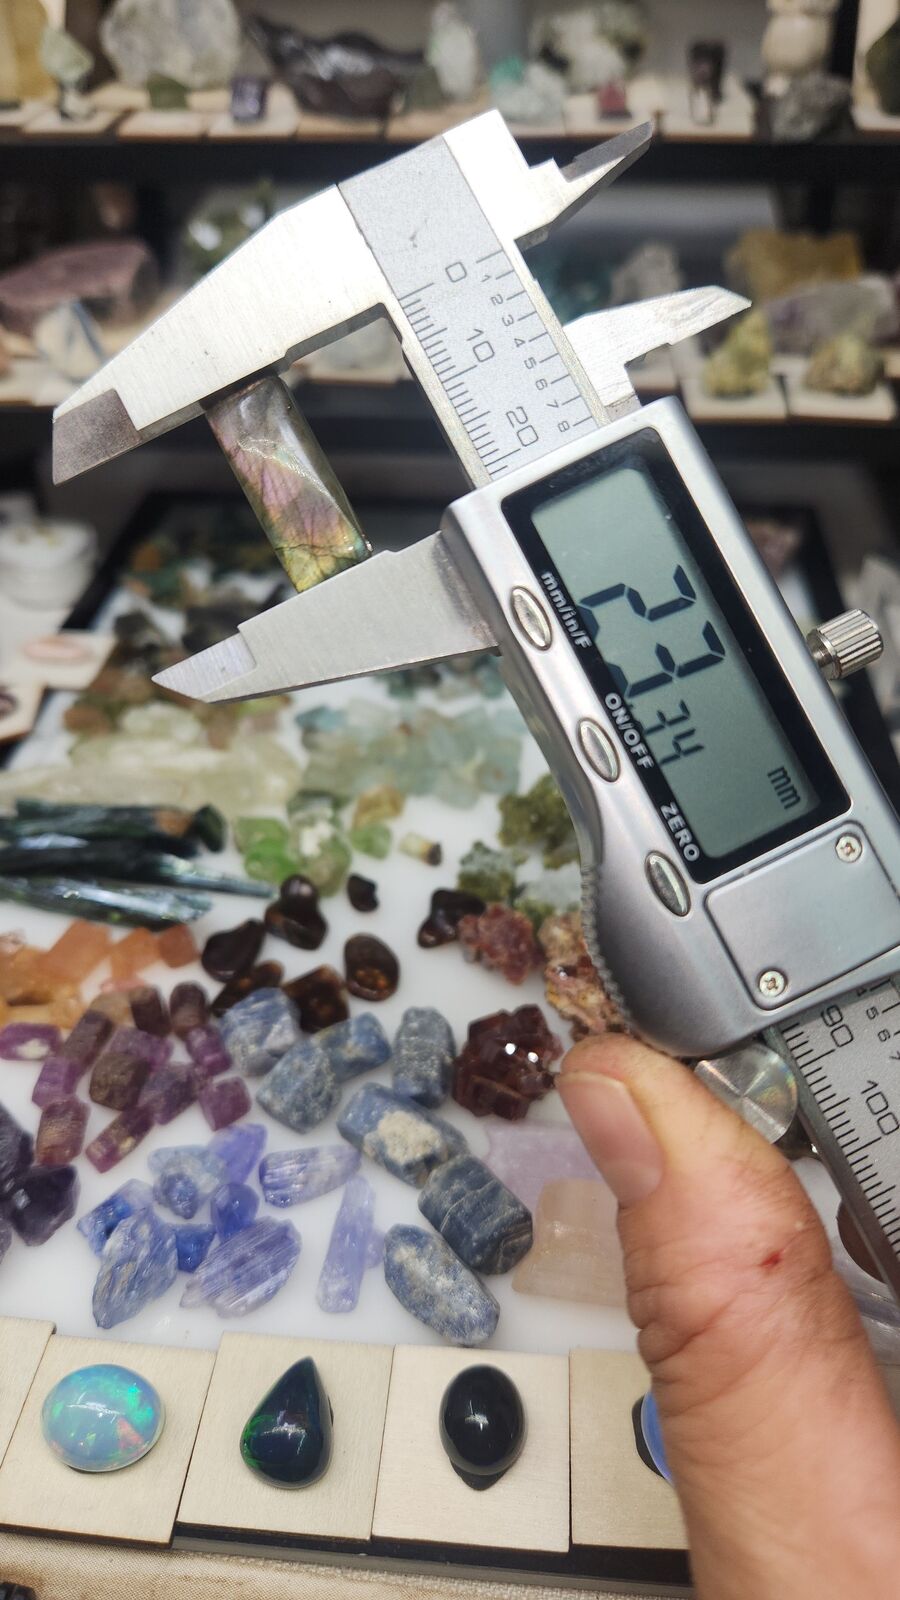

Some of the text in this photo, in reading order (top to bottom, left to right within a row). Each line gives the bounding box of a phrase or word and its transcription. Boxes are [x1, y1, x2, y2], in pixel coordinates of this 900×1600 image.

[445, 262, 539, 447] 0 10 20
[481, 274, 570, 433] 1 2 3 4 5 6 7 8
[541, 571, 593, 648] mm/in/F
[605, 692, 655, 768] ON/OFF
[767, 766, 800, 810] mm
[659, 801, 700, 862] ZERO
[866, 1006, 879, 1020] 5
[877, 1028, 890, 1042] 6
[820, 1005, 900, 1136] 90 100
